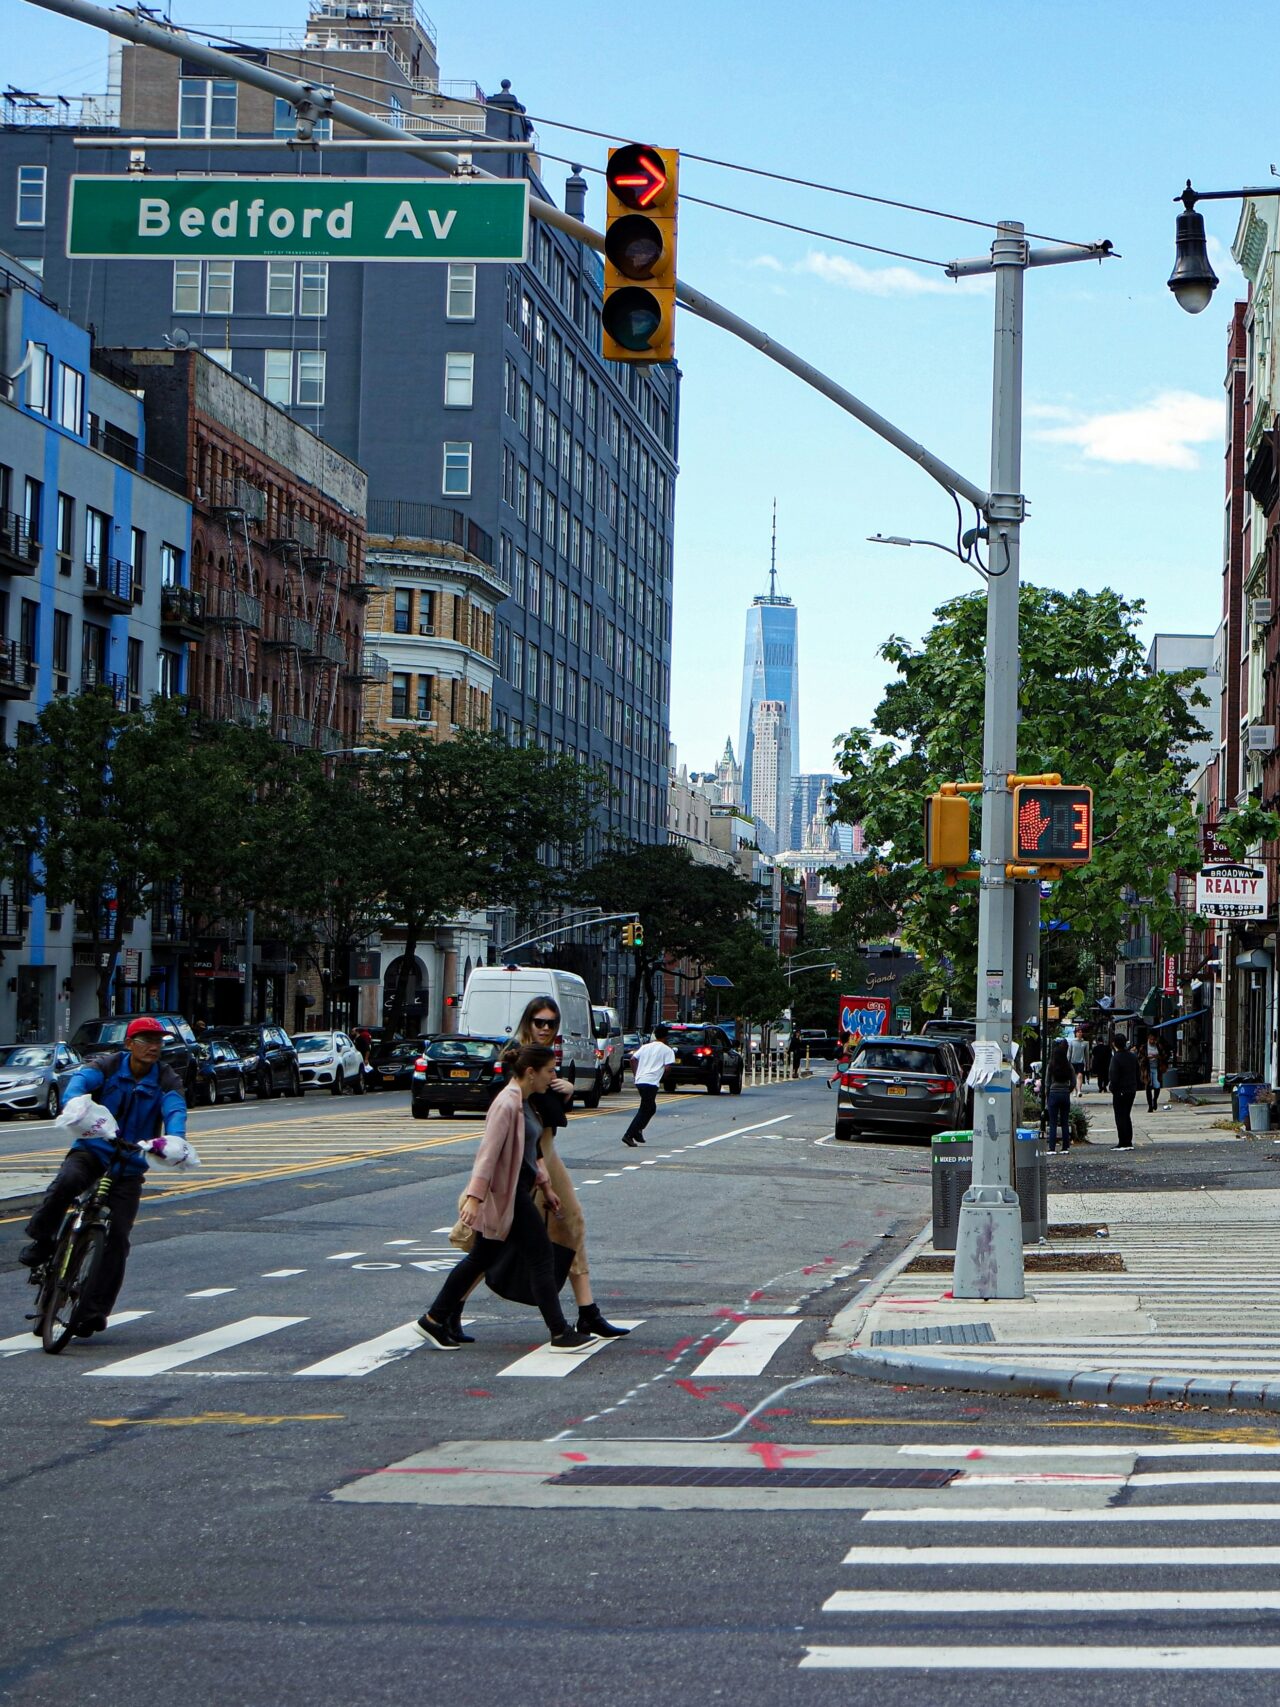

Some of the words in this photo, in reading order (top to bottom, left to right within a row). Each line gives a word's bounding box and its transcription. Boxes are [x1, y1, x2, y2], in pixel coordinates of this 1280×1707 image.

[138, 198, 354, 239] Bedford
[384, 200, 458, 240] Av
[1072, 804, 1088, 849] 3
[1205, 878, 1258, 894] REALTY
[1210, 869, 1254, 878] BROADWAY
[1168, 954, 1176, 987] ARDWARE
